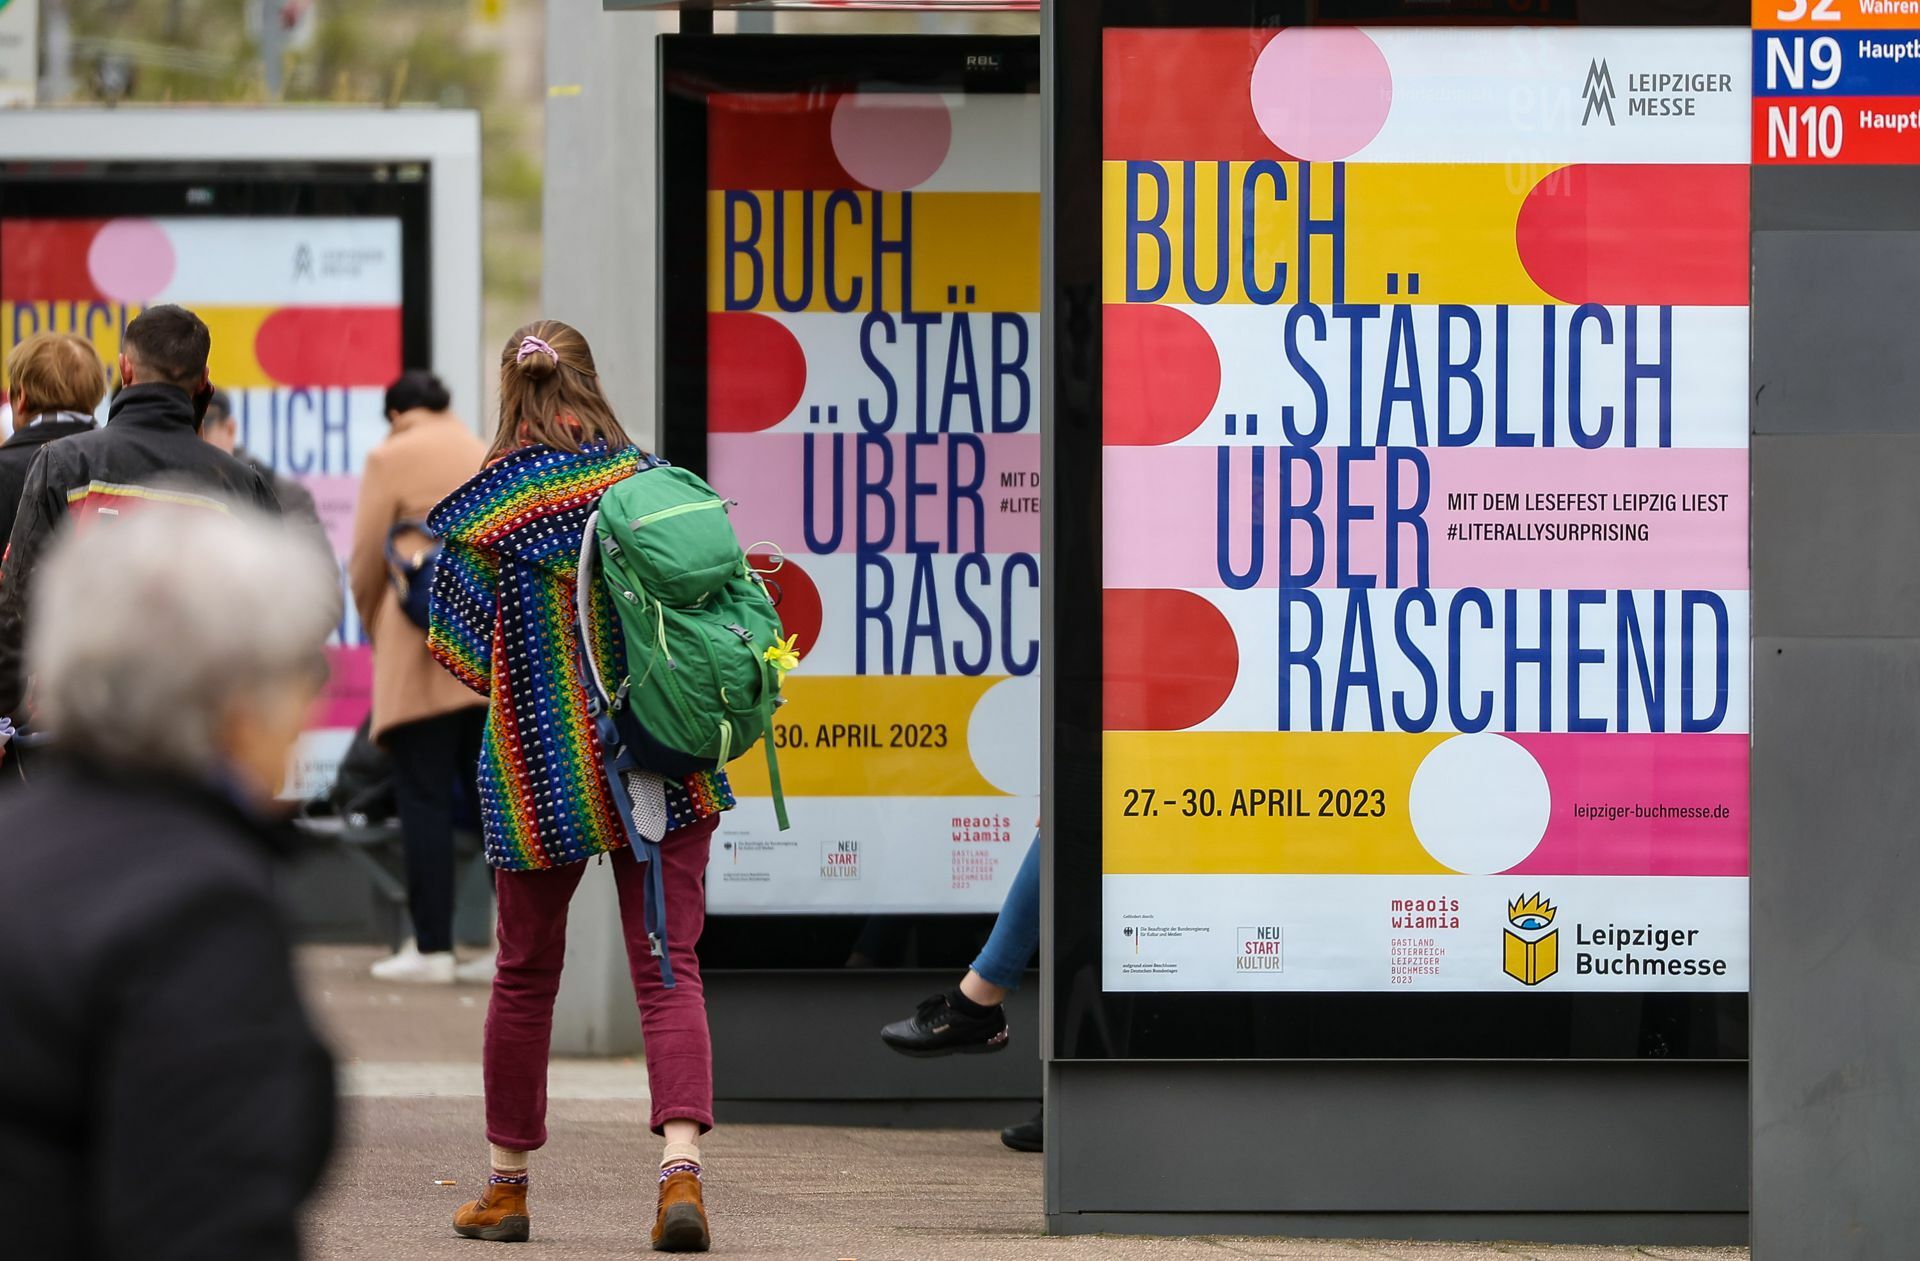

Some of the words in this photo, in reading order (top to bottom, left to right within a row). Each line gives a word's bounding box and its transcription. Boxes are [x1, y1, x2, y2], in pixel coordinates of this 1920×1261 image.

[967, 56, 999, 65] RBL
[1766, 37, 1842, 89] N9
[1629, 74, 1732, 92] LEIPZIGER
[1628, 98, 1695, 116] MESSE
[1767, 105, 1843, 158] N10
[1859, 109, 1920, 133] Haupt
[1125, 160, 1345, 304] BUCH
[724, 188, 912, 313] BUCH
[858, 285, 1031, 434] STÄB
[1283, 273, 1672, 449] STÄBLICH
[803, 405, 987, 555] ÜBER
[1001, 471, 1026, 488] MIT
[1216, 414, 1431, 590] ÜBER
[1448, 493, 1478, 511] MIT
[1483, 493, 1519, 511] DEM
[1525, 493, 1608, 512] LESEFEST
[1613, 494, 1676, 512] LEIPZIG
[1682, 494, 1728, 512] LIEST
[1447, 523, 1649, 541] #LITERALLYSURPRISING
[855, 551, 1040, 677] RASC
[1277, 587, 1730, 734] RASCHEND
[815, 724, 883, 748] APRIL
[890, 723, 948, 748] 2023
[1229, 788, 1310, 817] APRIL
[1317, 788, 1386, 817] 2023
[952, 814, 1010, 828] meaois
[1574, 803, 1730, 821] leipziger-buchmesse.de
[952, 828, 1010, 842] wiamia
[838, 841, 857, 852] NEU
[827, 853, 857, 865] START
[820, 866, 857, 878] KULTUR
[1391, 896, 1459, 912] meaois
[1391, 913, 1460, 929] wiamia
[1257, 927, 1280, 939] NEU
[1576, 923, 1699, 951] Leipziger
[1245, 942, 1280, 955] START
[1391, 939, 1434, 947] GASTLAND
[1391, 946, 1445, 956] ÖSTERREICH
[1236, 956, 1280, 970] KULTUR
[1391, 957, 1440, 965] LEIPZIGER
[1576, 953, 1727, 975] Buchmesse
[1391, 966, 1440, 975] BUCHMESSE
[1391, 976, 1413, 984] 2023
